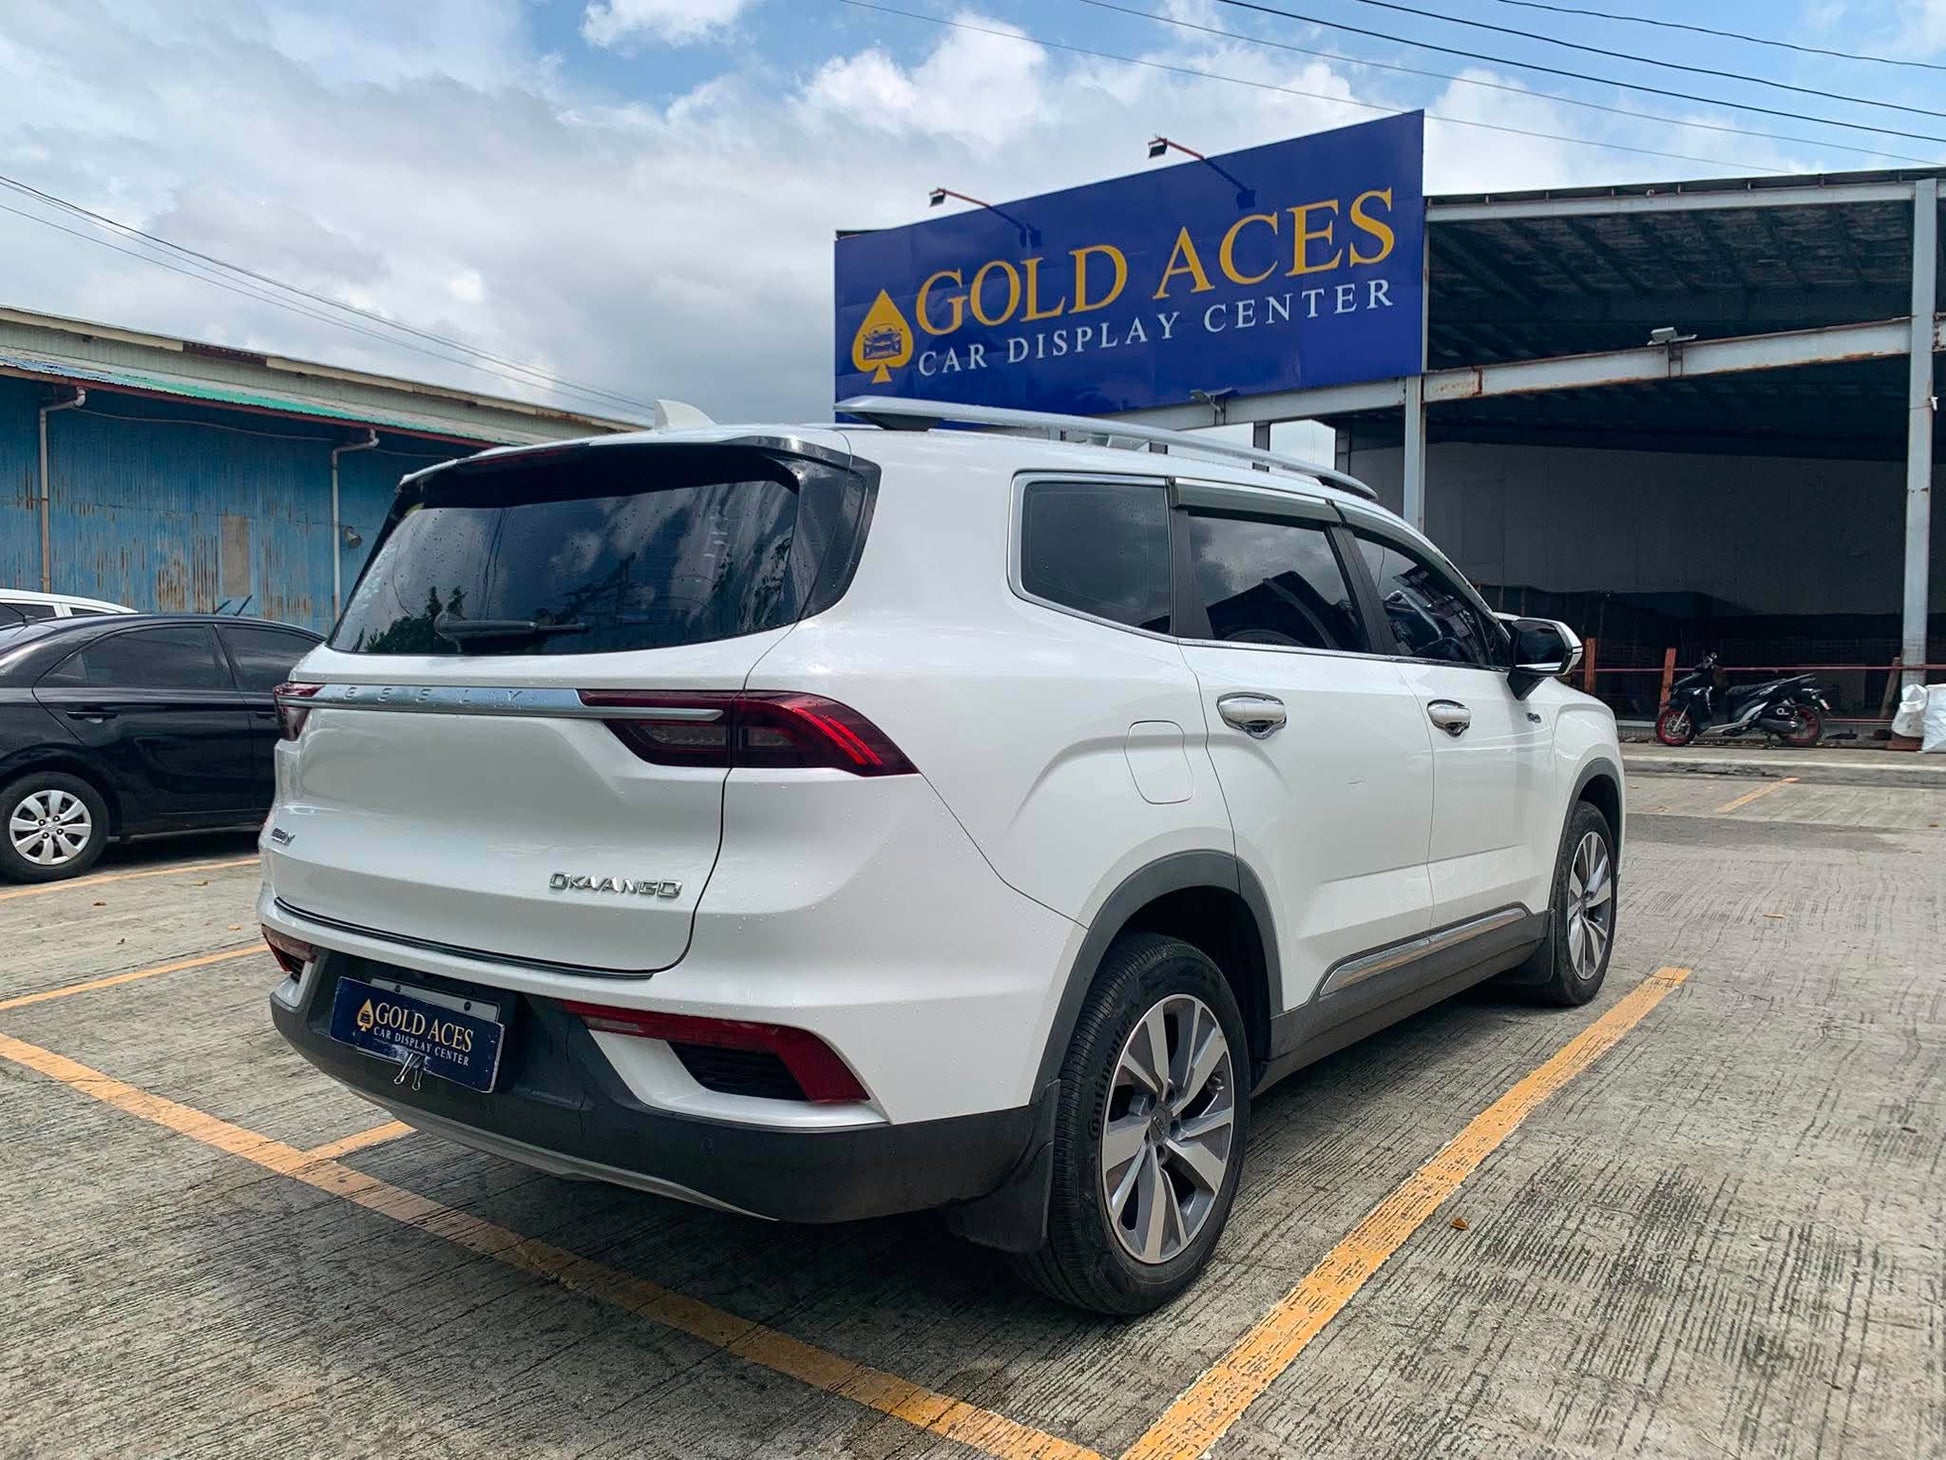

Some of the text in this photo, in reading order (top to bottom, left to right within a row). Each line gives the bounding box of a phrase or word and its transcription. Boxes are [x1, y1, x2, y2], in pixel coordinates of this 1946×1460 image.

[915, 186, 1396, 337] GOLD ACES
[917, 278, 1395, 378] CAR DISPLAY CENTER
[373, 1026, 470, 1067] CAR DISPLAY CENTER
[375, 1002, 474, 1053] GOLD ACES
